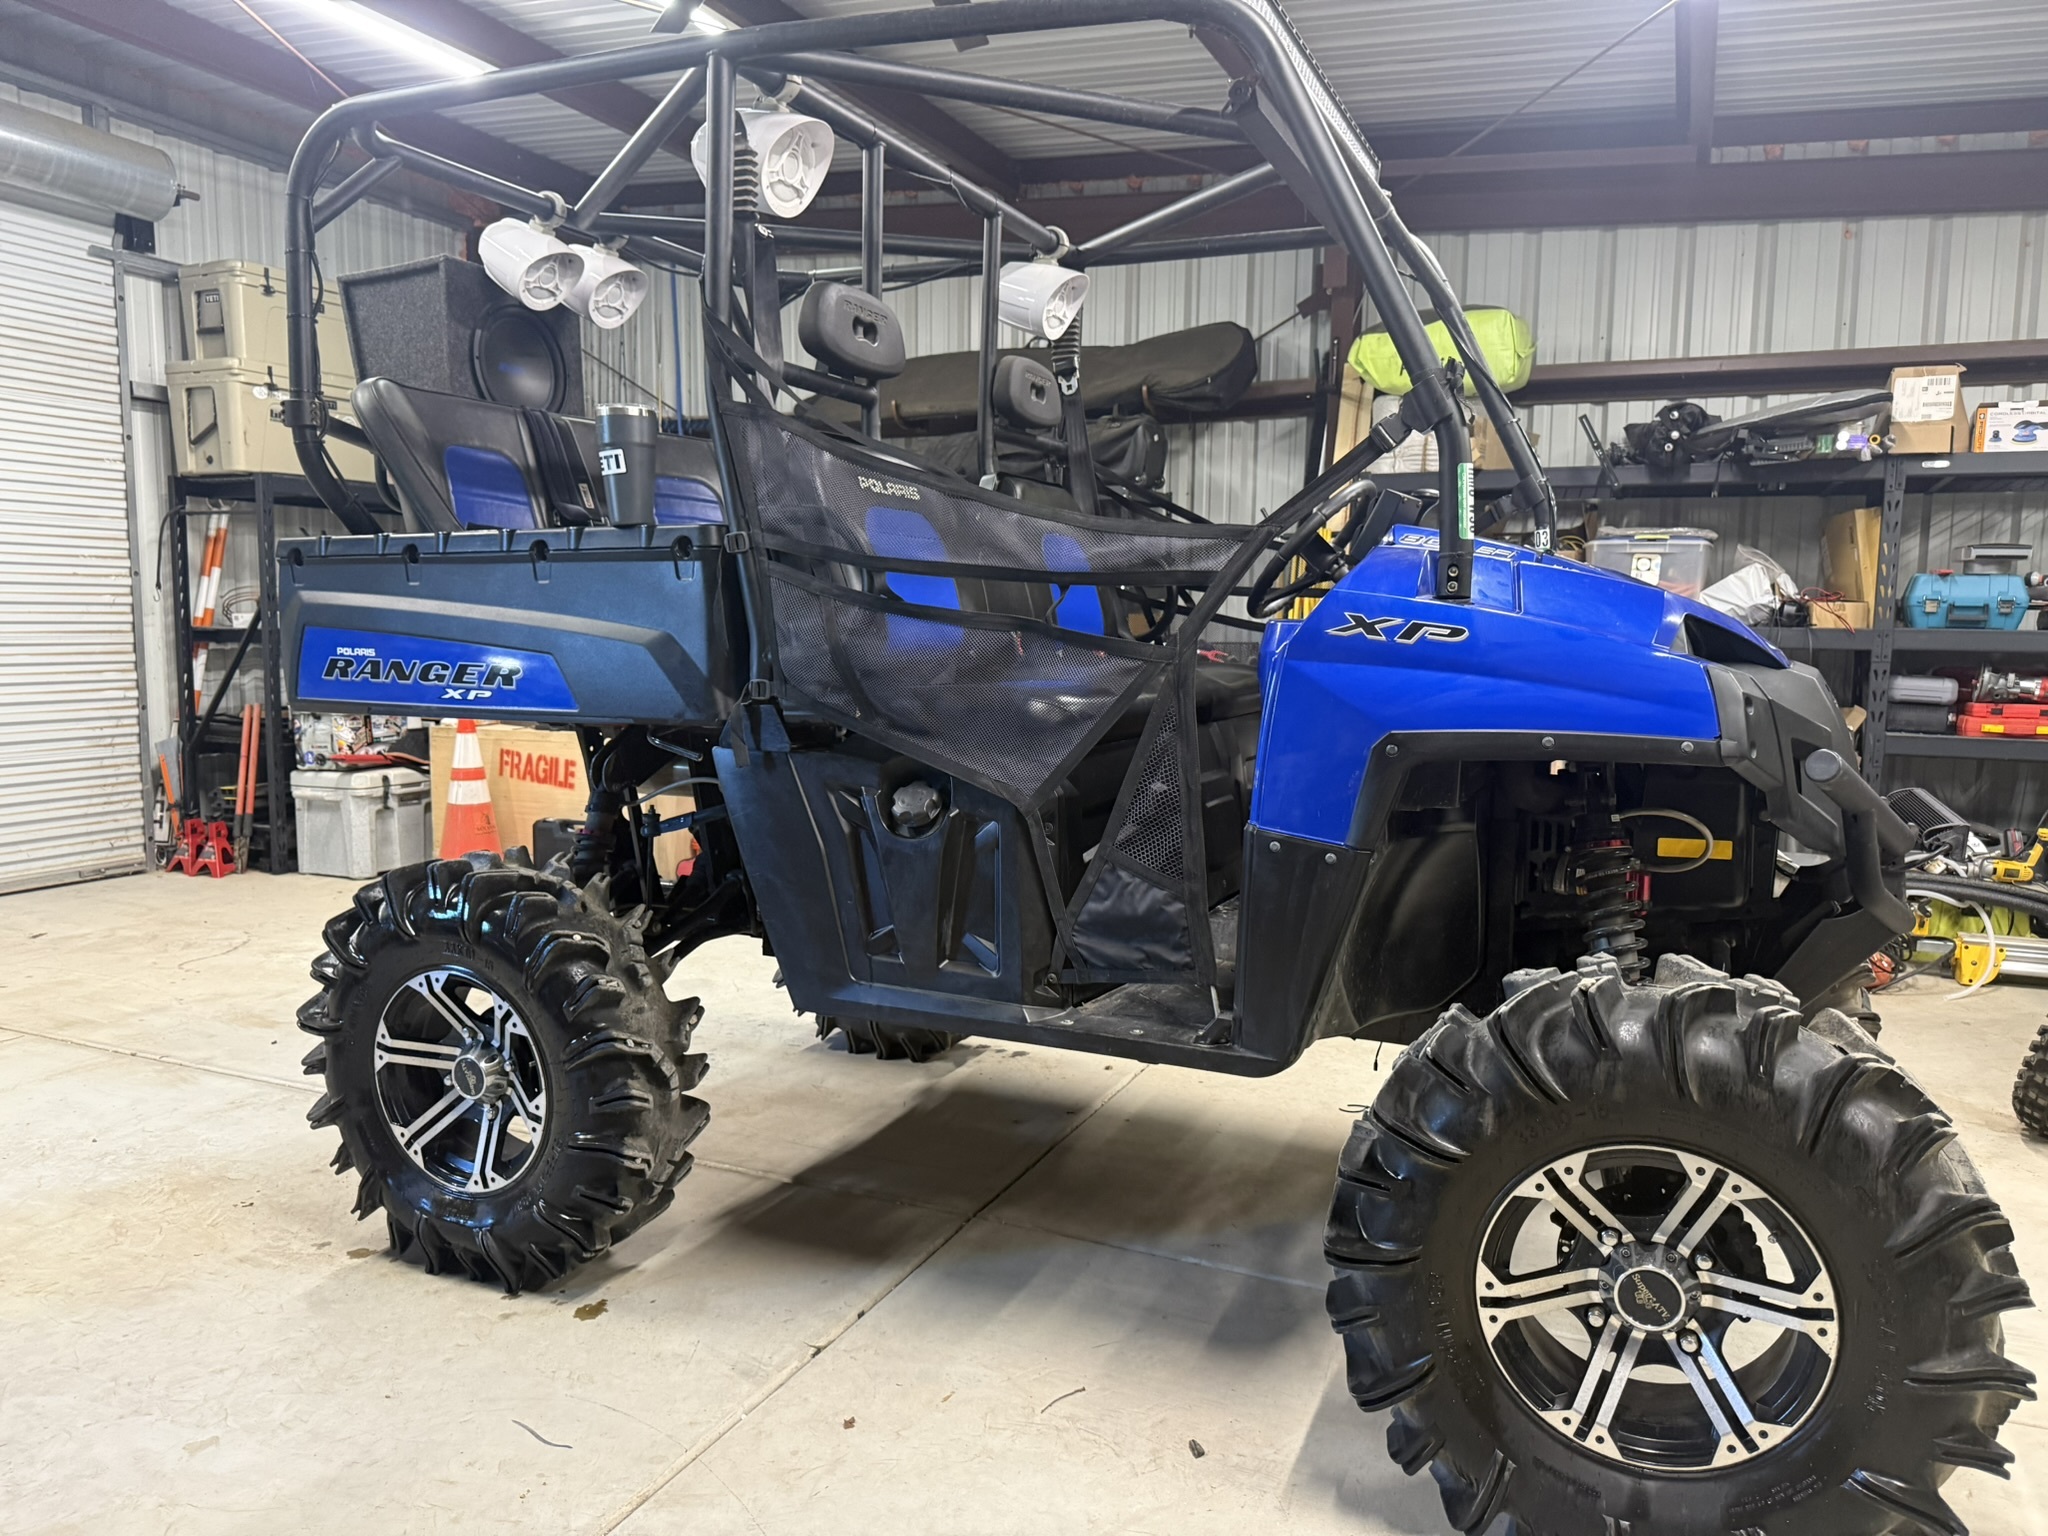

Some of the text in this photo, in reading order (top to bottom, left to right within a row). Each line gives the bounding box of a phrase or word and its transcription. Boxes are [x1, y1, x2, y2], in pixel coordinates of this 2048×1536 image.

[843, 299, 888, 325] RANGER
[600, 453, 621, 471] ETI
[857, 476, 920, 500] POLARIS
[1535, 531, 1549, 548] 03
[1475, 545, 1520, 560] EFI
[1325, 612, 1469, 645] XP
[336, 647, 376, 657] POLARIS
[321, 656, 524, 689] RANGER
[440, 687, 493, 701] XP
[498, 747, 577, 791] FRAGILE
